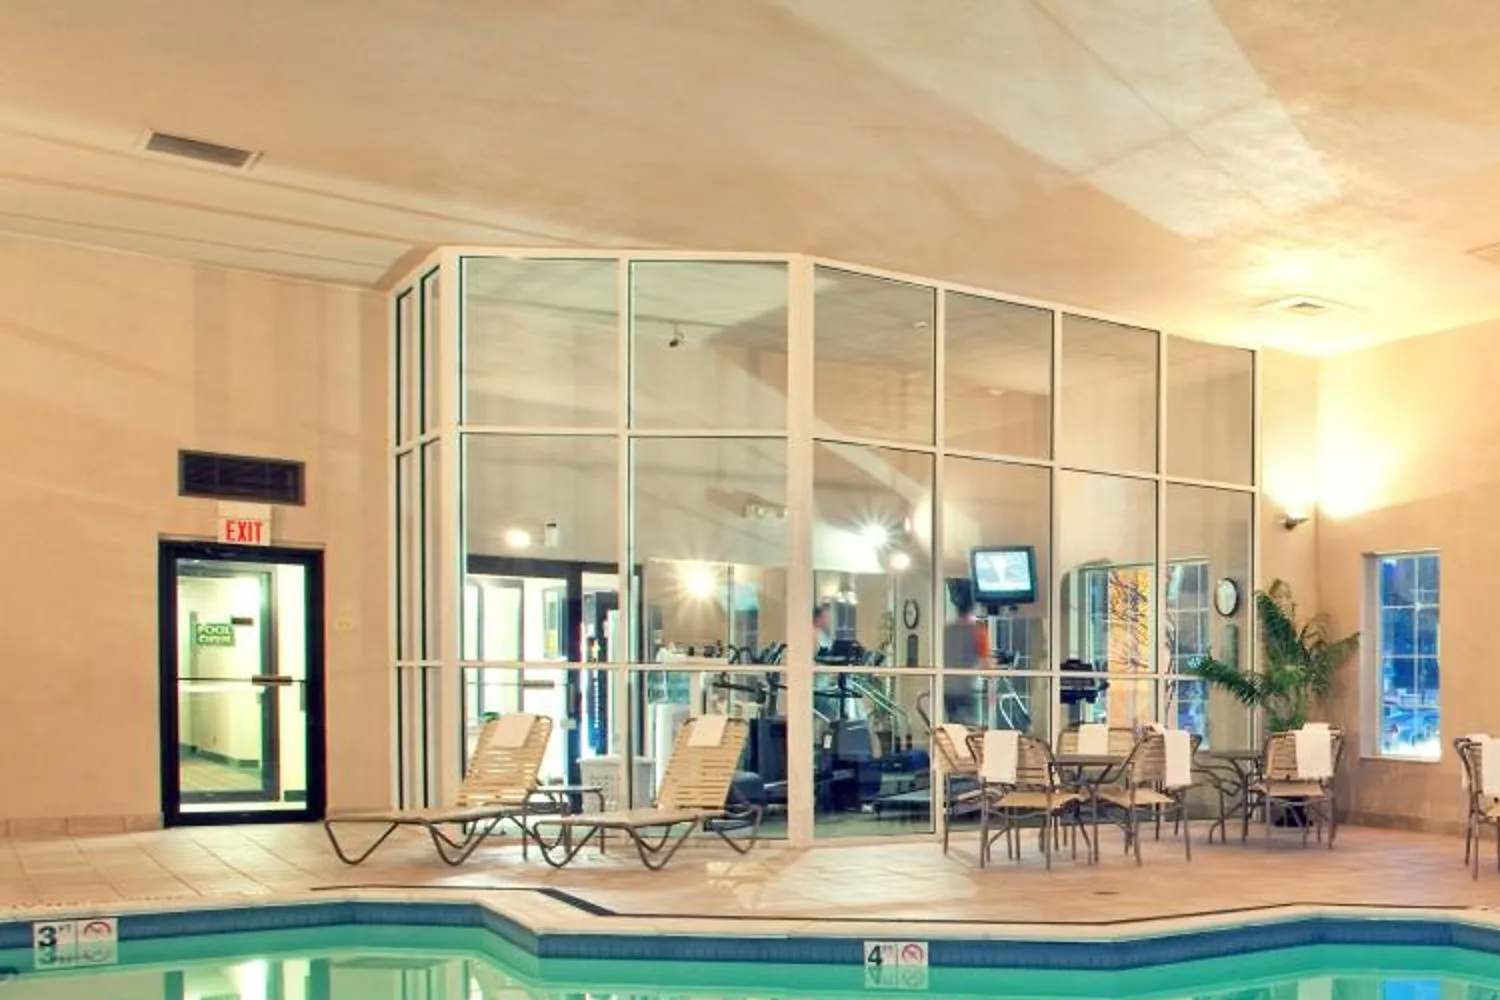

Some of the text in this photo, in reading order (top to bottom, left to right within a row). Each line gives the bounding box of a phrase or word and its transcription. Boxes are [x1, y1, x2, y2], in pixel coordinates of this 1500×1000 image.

[225, 519, 263, 543] EXIT
[38, 925, 57, 947] 3
[867, 944, 883, 966] 4
